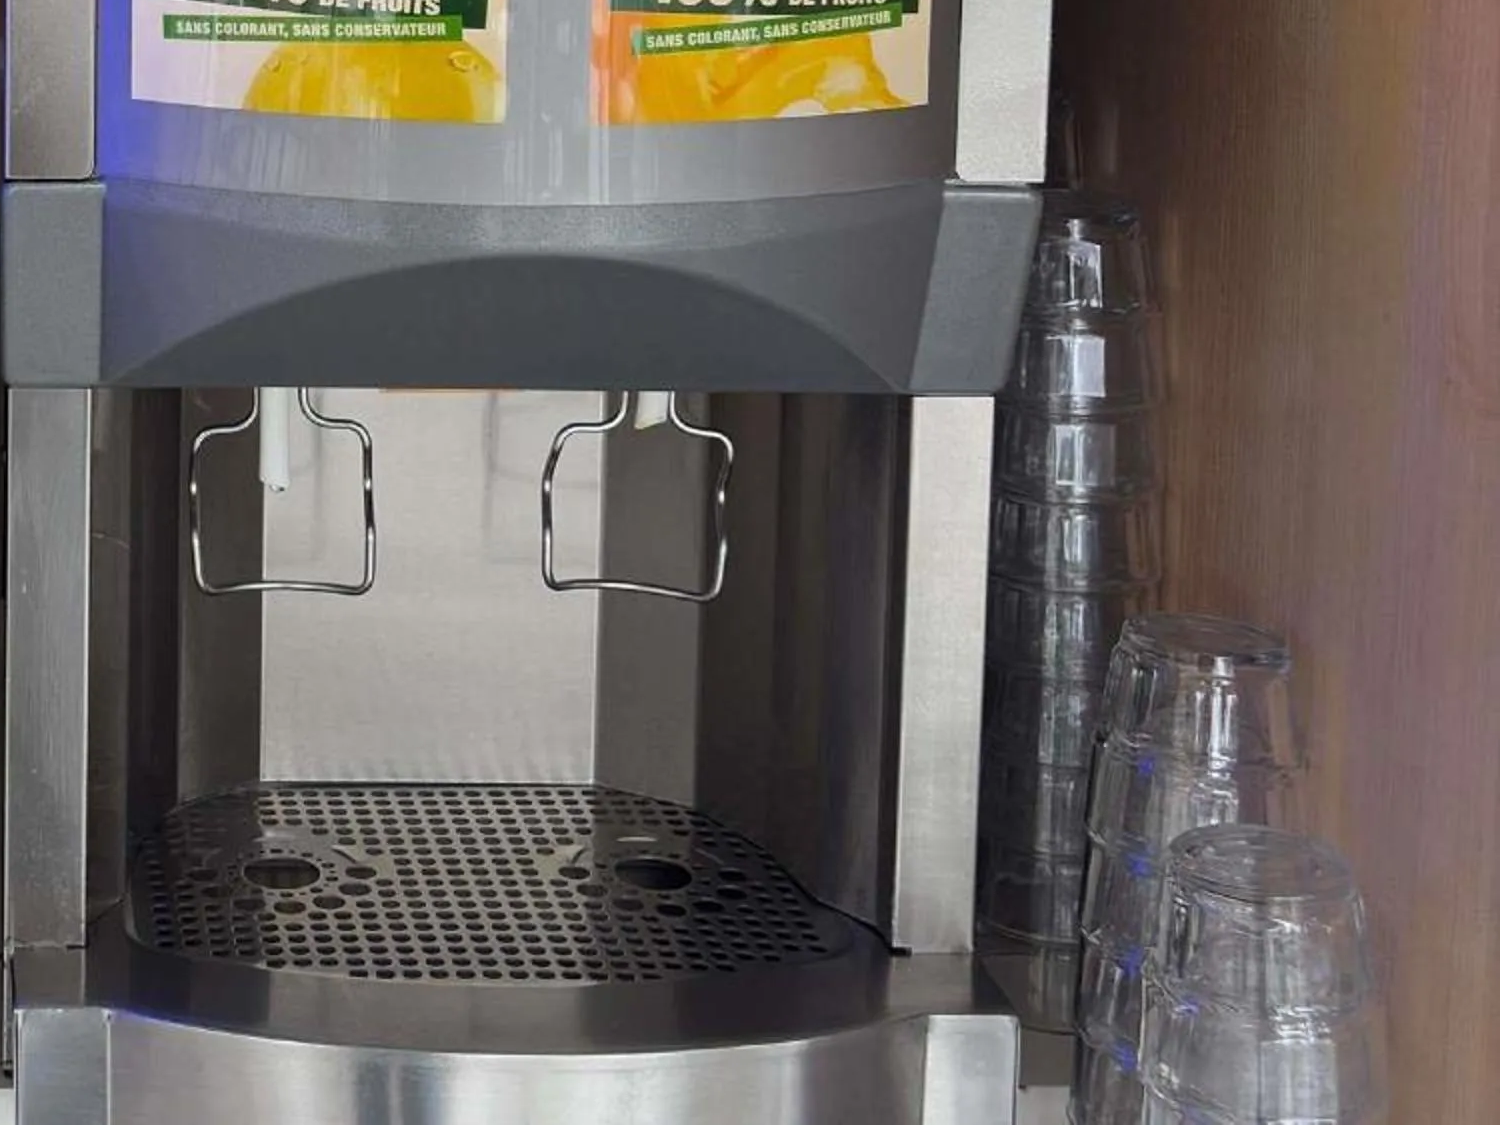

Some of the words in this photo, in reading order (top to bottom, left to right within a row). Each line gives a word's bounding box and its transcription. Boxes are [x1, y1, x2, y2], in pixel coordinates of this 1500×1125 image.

[176, 20, 211, 35] SANS
[215, 21, 289, 37] COLORANT,
[293, 22, 330, 37] SANS
[335, 21, 447, 37] CONSERVATEUR
[646, 33, 683, 48] SANS
[687, 28, 761, 46] COLORANT,
[763, 22, 799, 39] SANS
[802, 10, 892, 35] CONSERVATEUR
